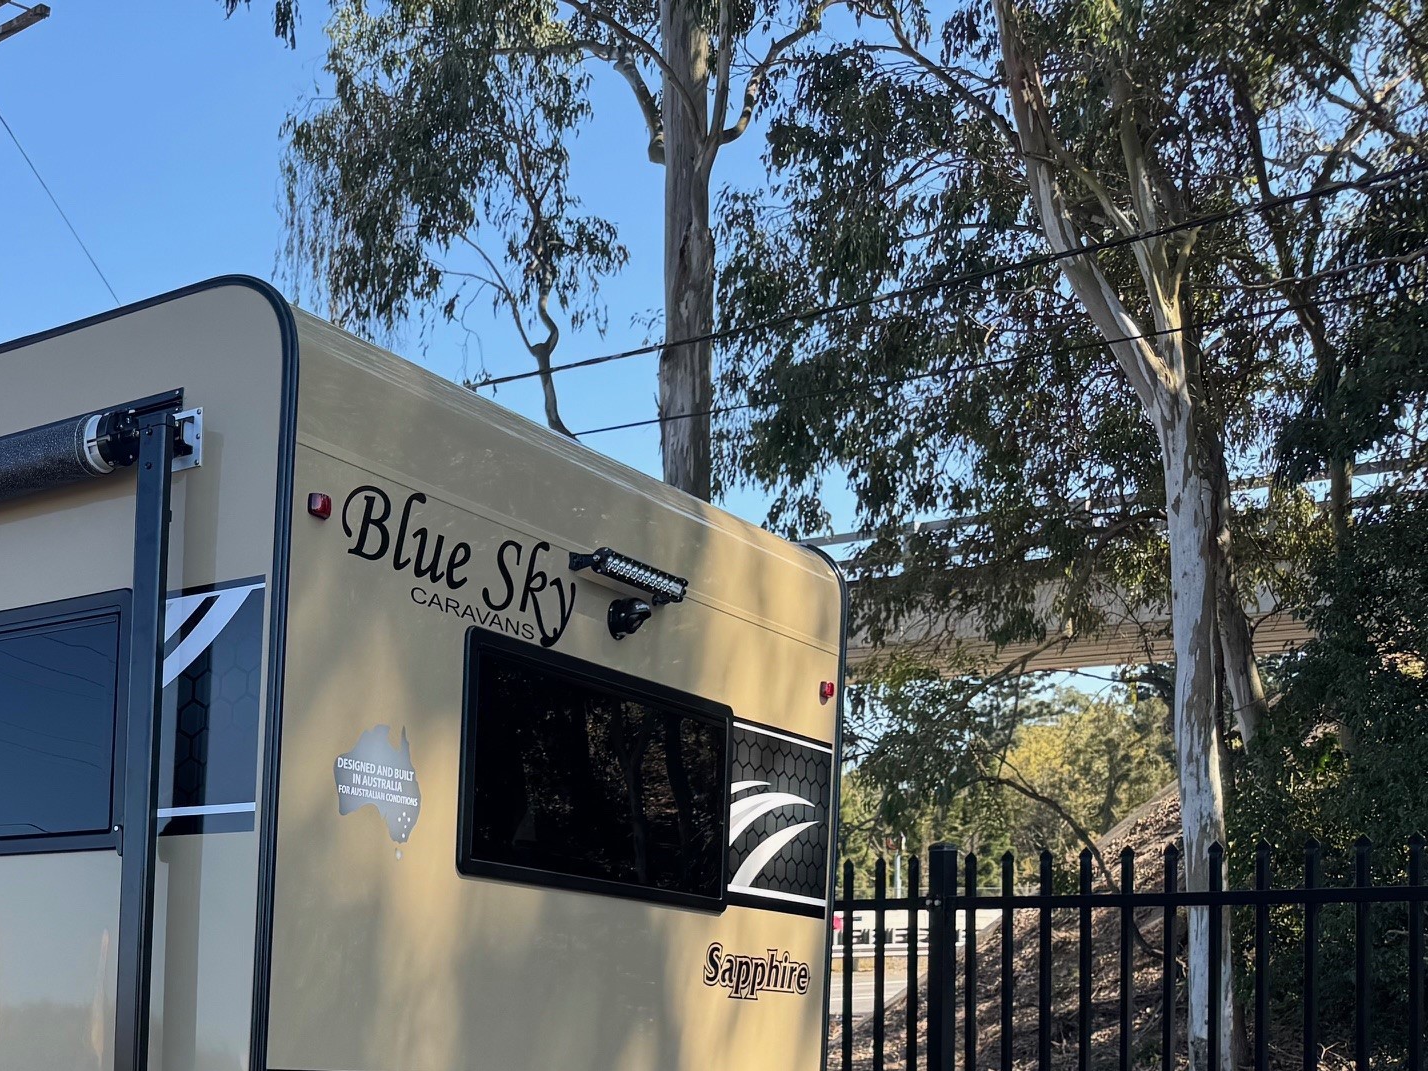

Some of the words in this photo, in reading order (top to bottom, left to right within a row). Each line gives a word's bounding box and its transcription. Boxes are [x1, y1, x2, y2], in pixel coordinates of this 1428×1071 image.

[341, 485, 472, 590] Blue
[481, 540, 577, 648] Sky
[410, 586, 536, 641] CARAVANS
[337, 756, 376, 774] DESIGNED
[376, 765, 393, 778] AND
[394, 768, 415, 782] BUILT
[352, 773, 361, 785] IN
[362, 776, 403, 792] AUSTRALIA
[338, 784, 351, 795] FOR
[350, 786, 385, 801] AUSTRALIAN
[385, 793, 418, 807] CONDITIONS
[703, 941, 811, 1001] Sapphire
